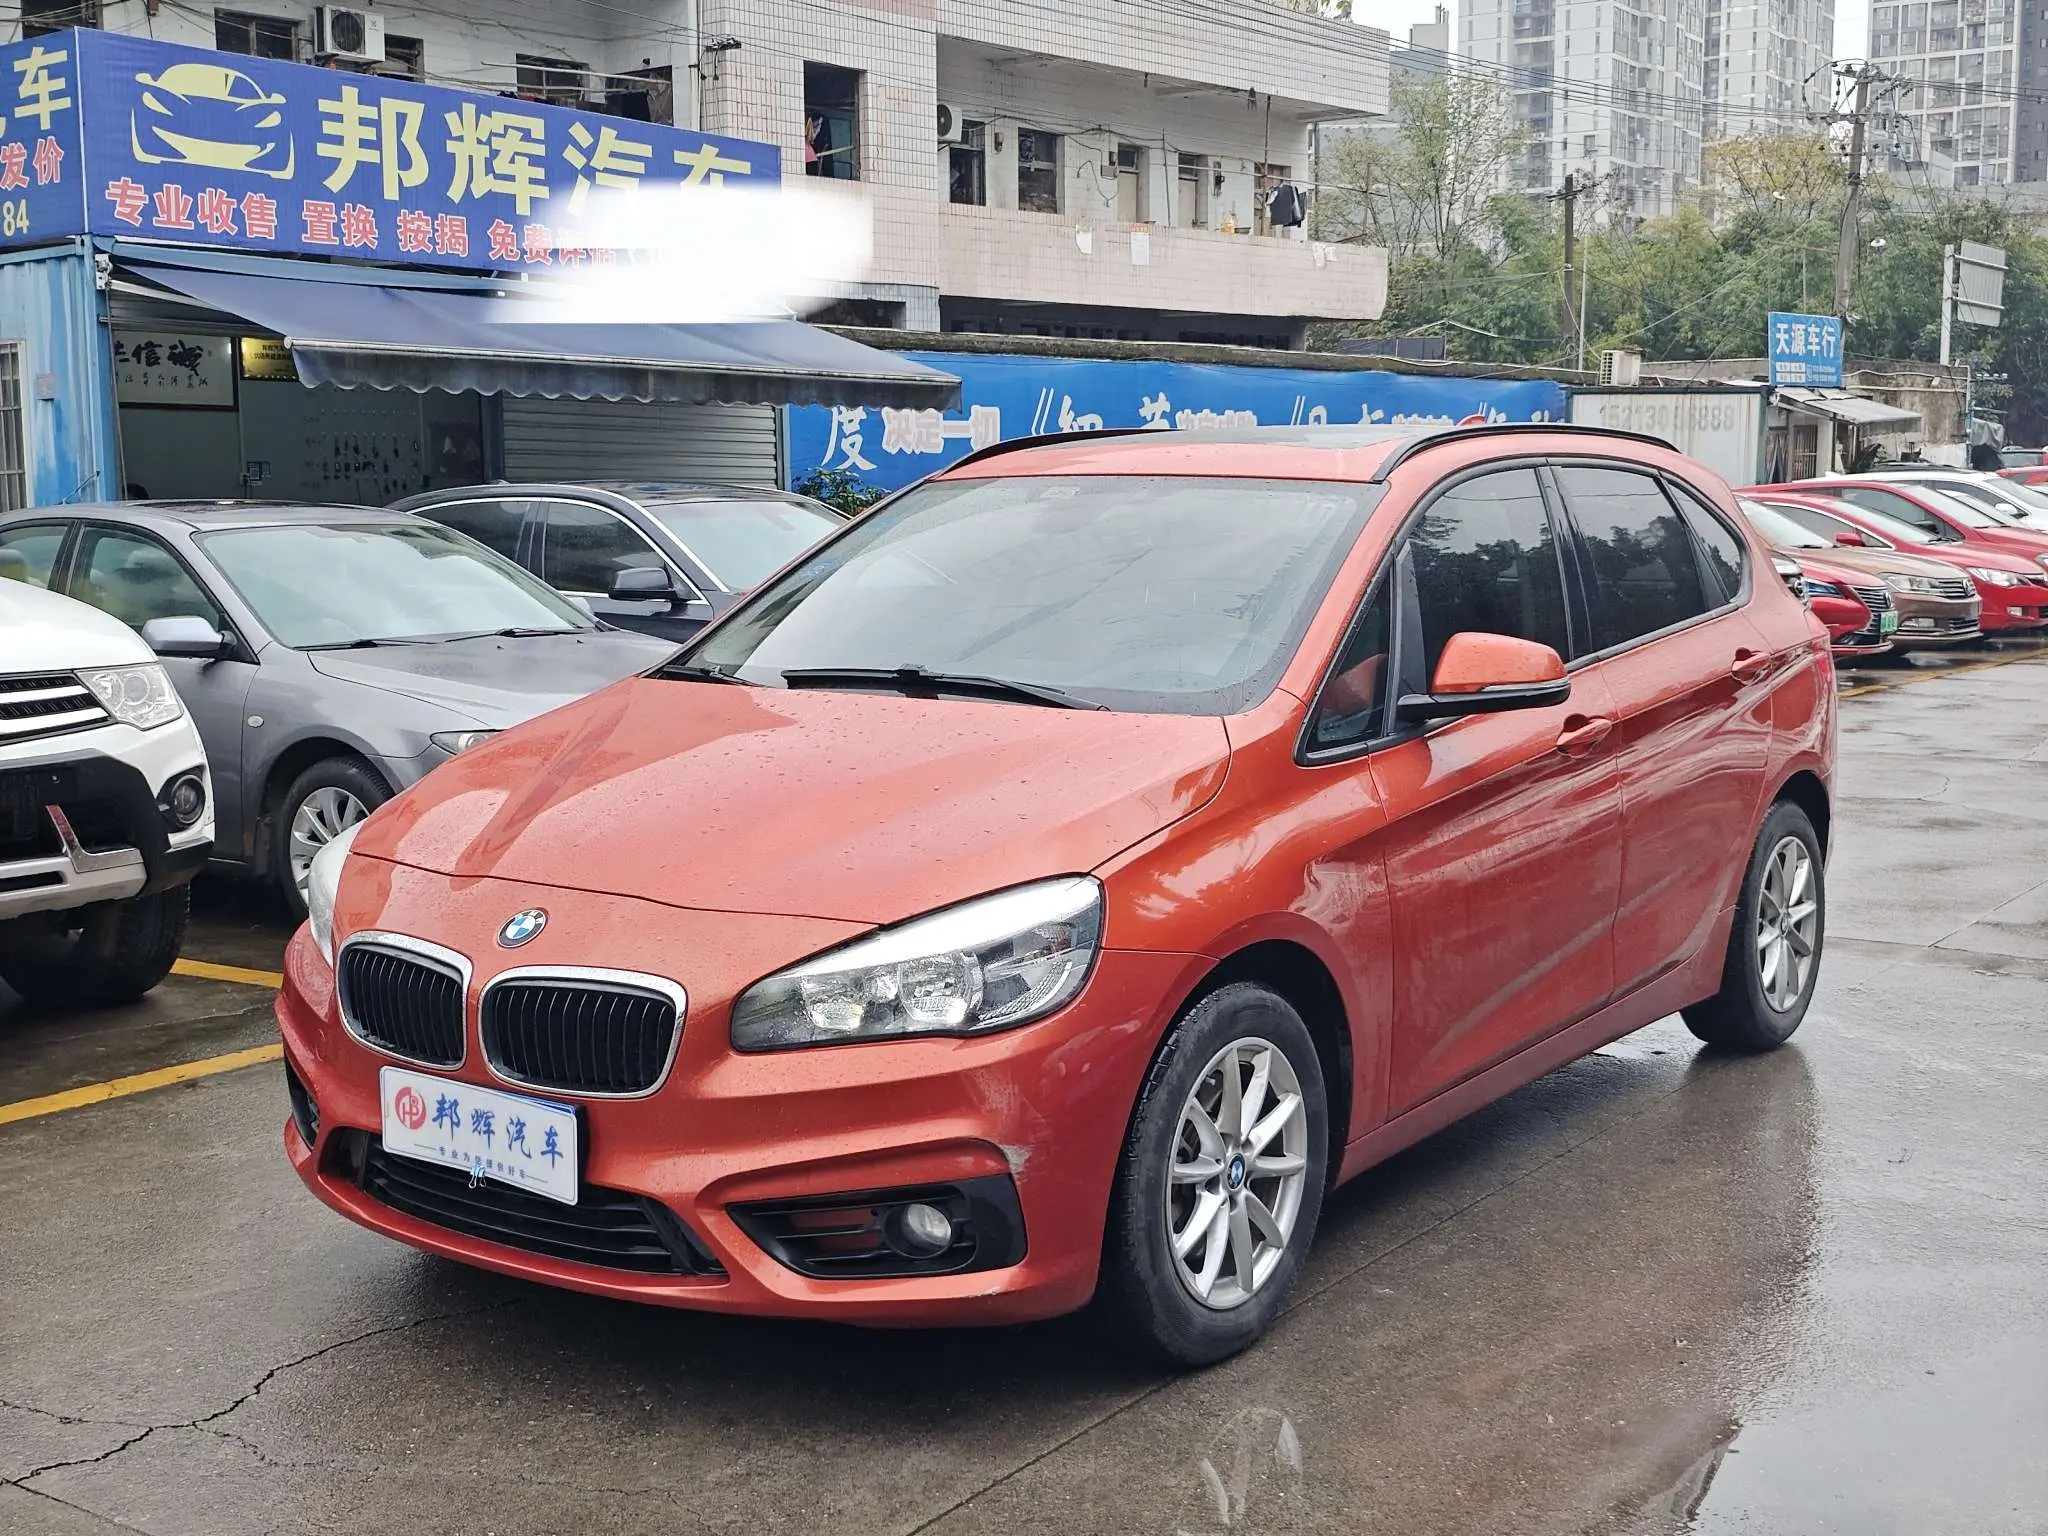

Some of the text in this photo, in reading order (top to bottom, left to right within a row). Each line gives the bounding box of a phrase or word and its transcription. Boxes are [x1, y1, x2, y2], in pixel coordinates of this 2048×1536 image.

[0, 47, 71, 138] 车
[0, 136, 64, 191] 发价
[3, 199, 30, 237] 84
[105, 177, 278, 240] 专业收售
[302, 200, 378, 249] 置换
[397, 210, 469, 258] 按揭
[1775, 323, 1836, 358] 天源车行
[432, 1093, 564, 1169] 邦辉汽车
